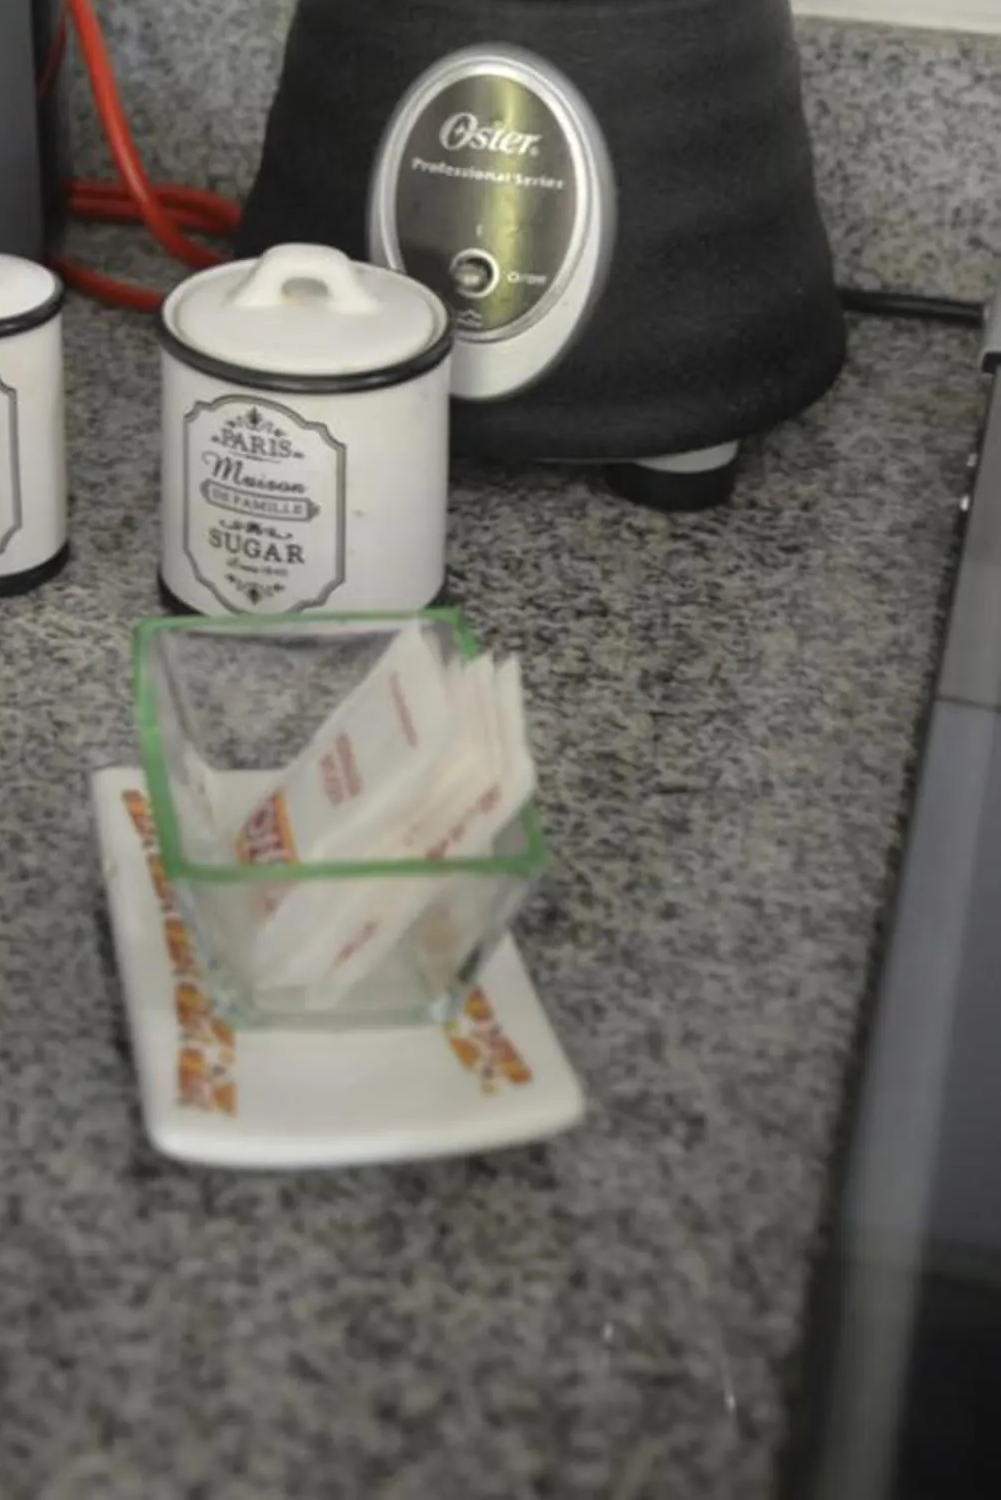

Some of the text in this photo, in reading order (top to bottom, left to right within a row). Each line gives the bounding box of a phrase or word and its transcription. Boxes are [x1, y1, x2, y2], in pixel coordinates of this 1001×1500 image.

[439, 111, 542, 156] Oster
[411, 157, 566, 190] Professional Series
[221, 428, 293, 458] PARIS
[202, 451, 305, 493] Maison
[208, 527, 306, 565] SUGAR
